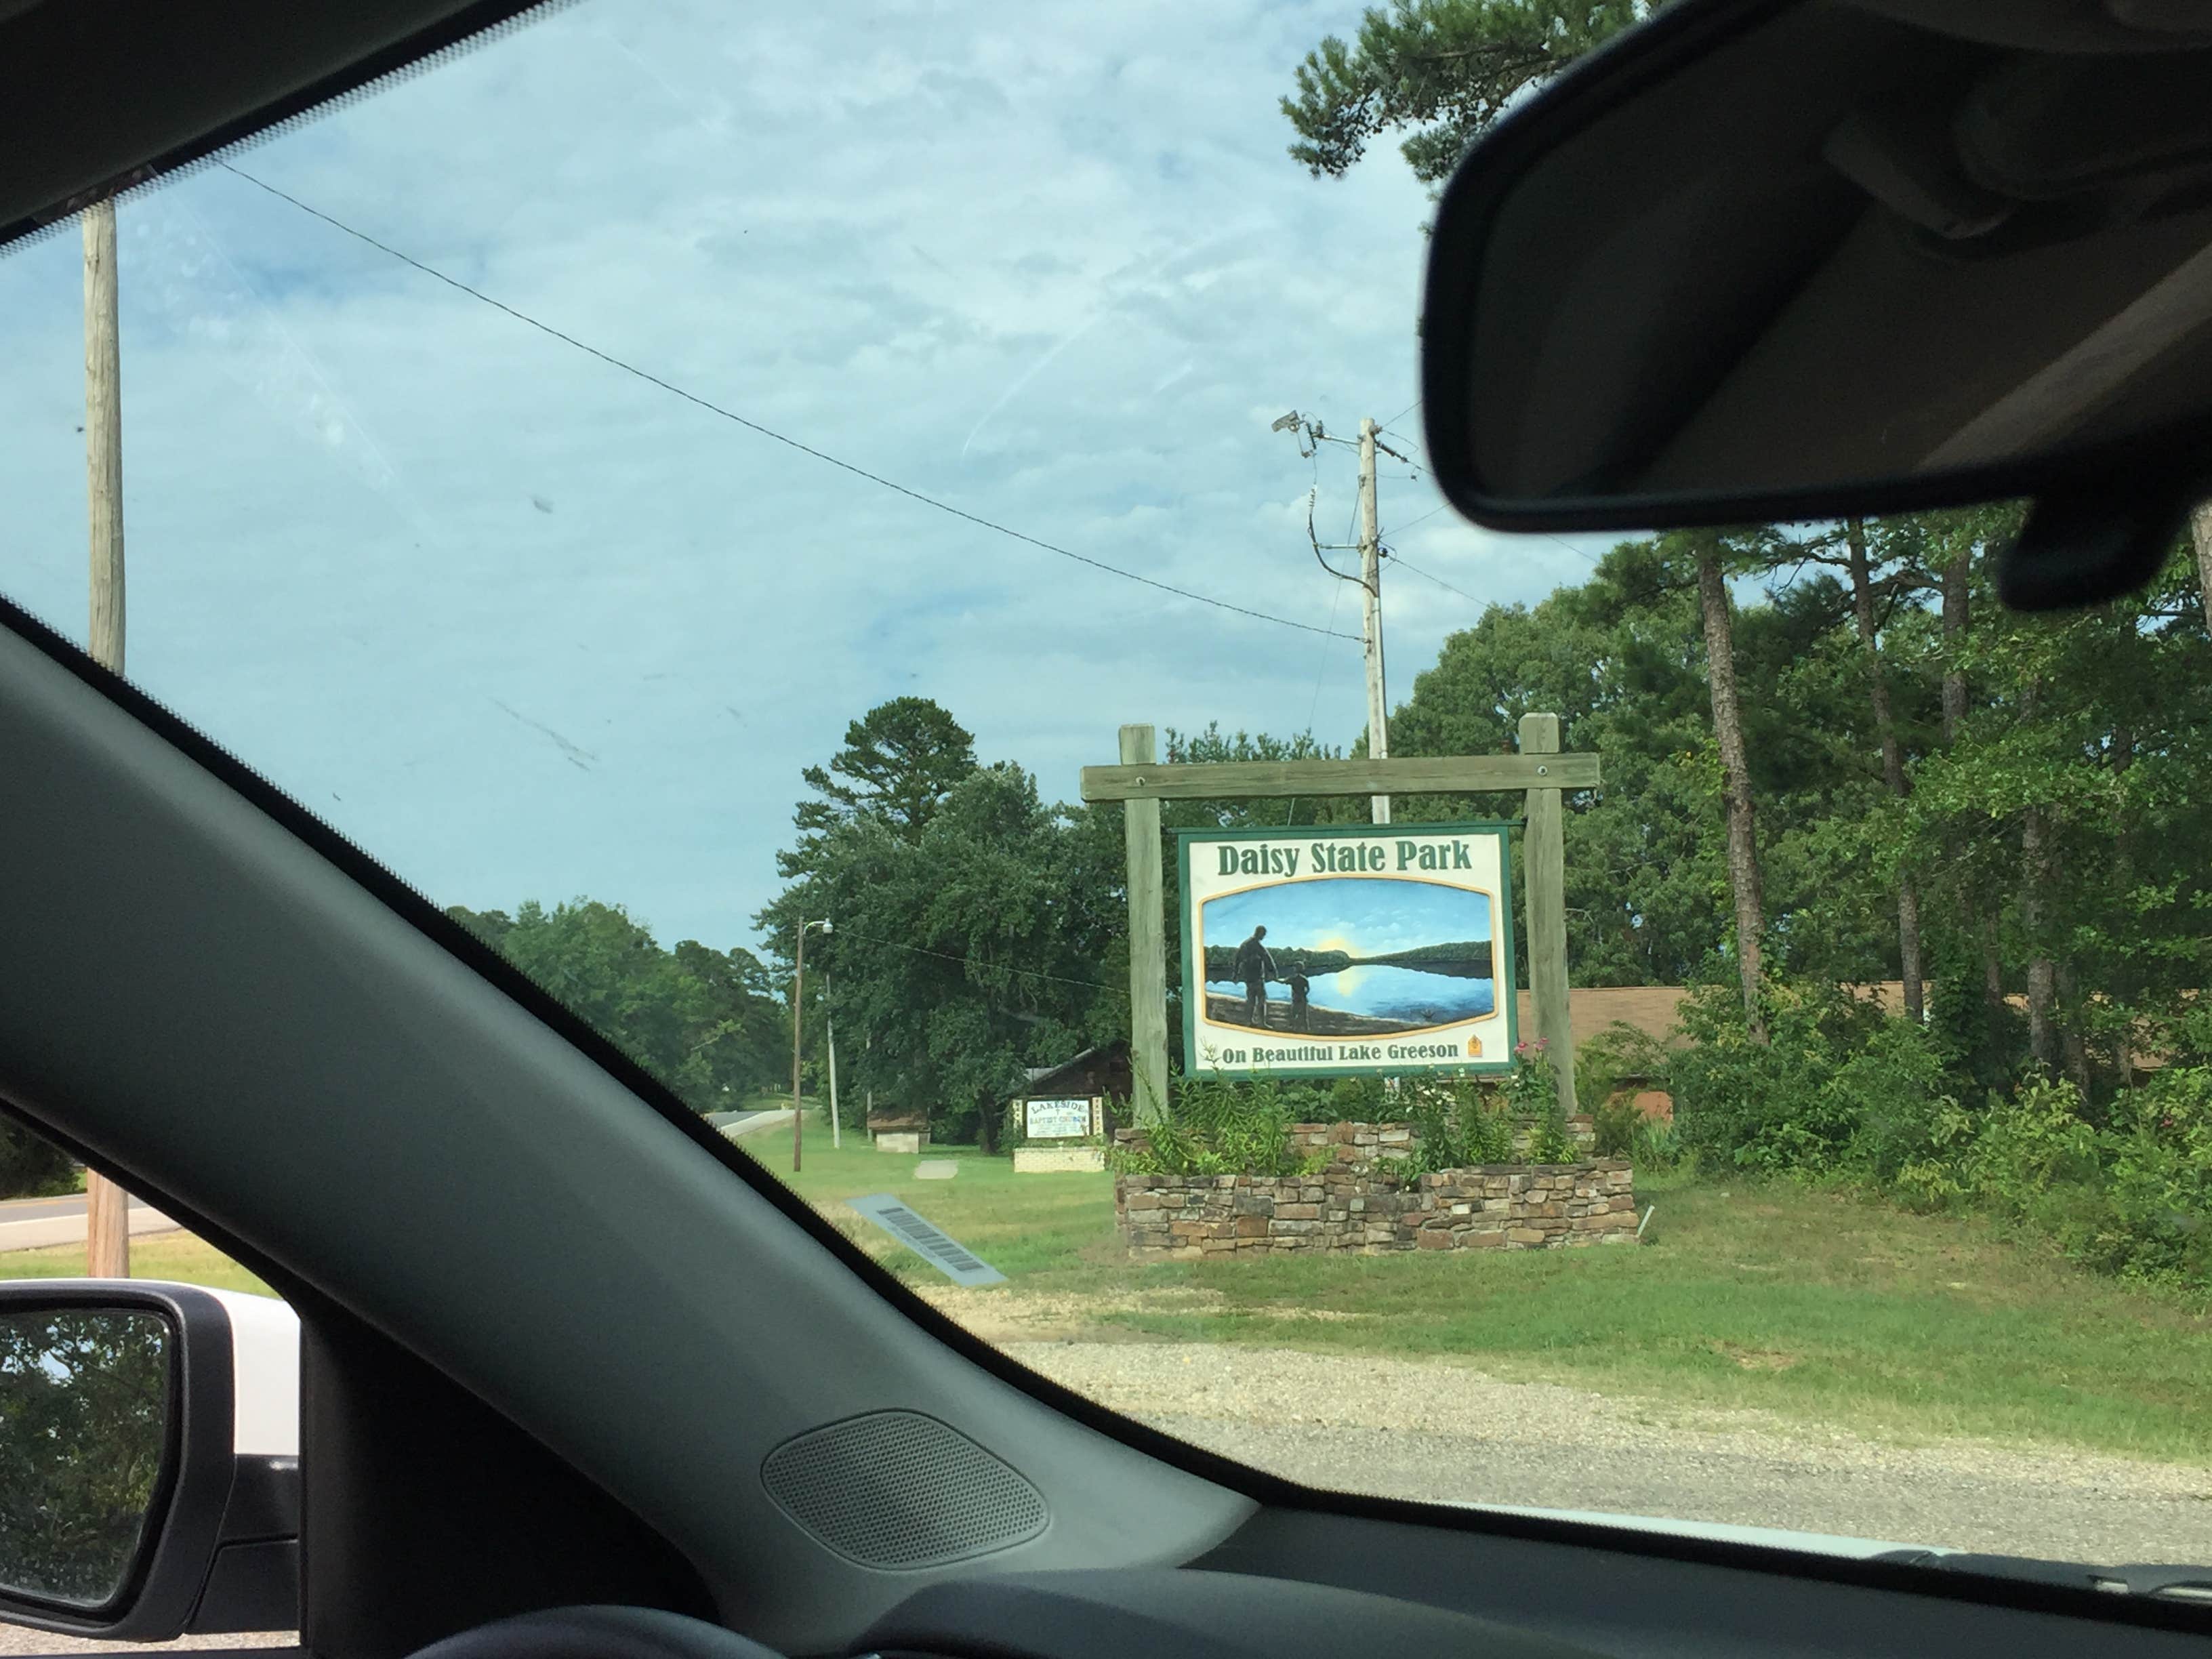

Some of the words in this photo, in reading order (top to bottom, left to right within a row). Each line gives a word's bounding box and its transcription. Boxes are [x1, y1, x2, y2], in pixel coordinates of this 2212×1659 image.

[1218, 843, 1300, 877] Daisy
[1311, 841, 1386, 873] State
[1396, 840, 1472, 871] Park
[1223, 1048, 1246, 1064] On
[1253, 1046, 1333, 1063] Beautiful
[1339, 1045, 1382, 1061] Lake
[1387, 1043, 1458, 1059] Greeson
[1031, 1100, 1085, 1114] LAKESIDE
[1029, 1116, 1057, 1124] BAPTIST
